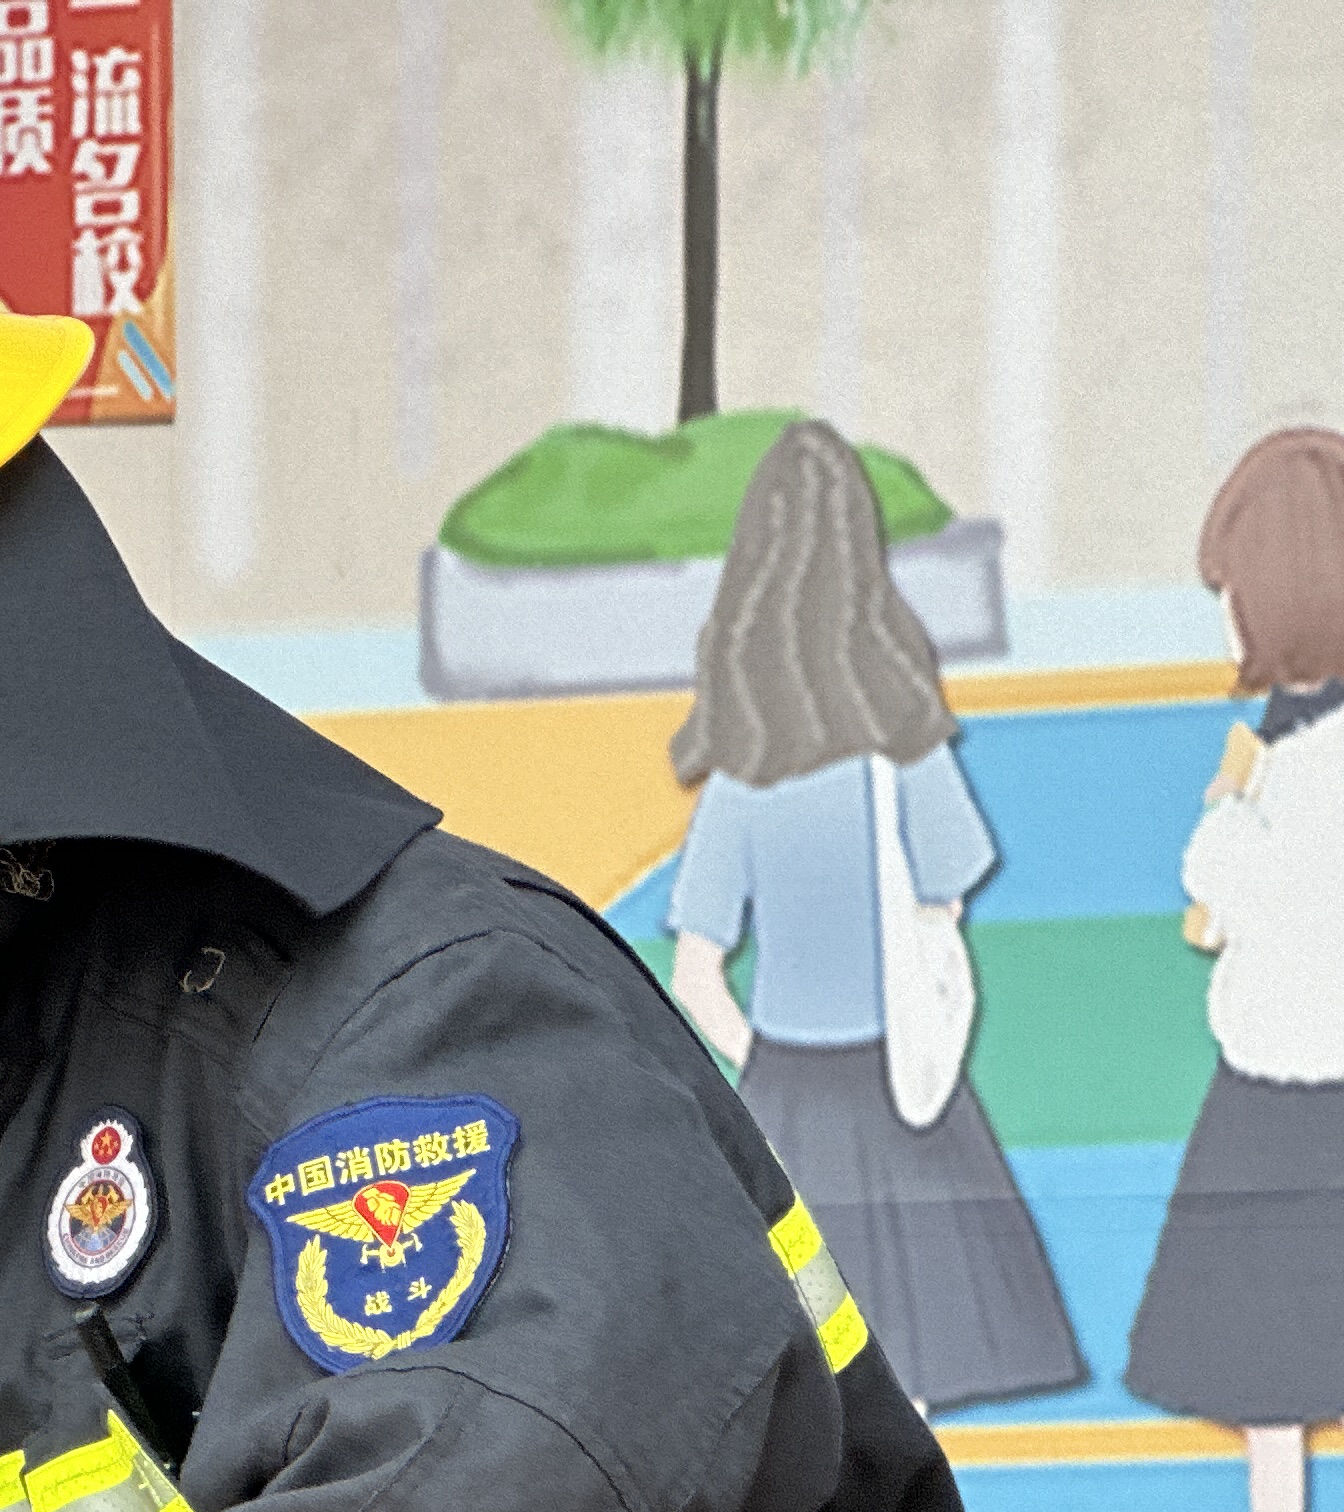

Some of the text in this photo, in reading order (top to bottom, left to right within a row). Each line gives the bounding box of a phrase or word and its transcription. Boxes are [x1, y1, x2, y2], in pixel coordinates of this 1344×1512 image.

[264, 1119, 491, 1206] 中国消防救援
[364, 1276, 433, 1316] 战斗
